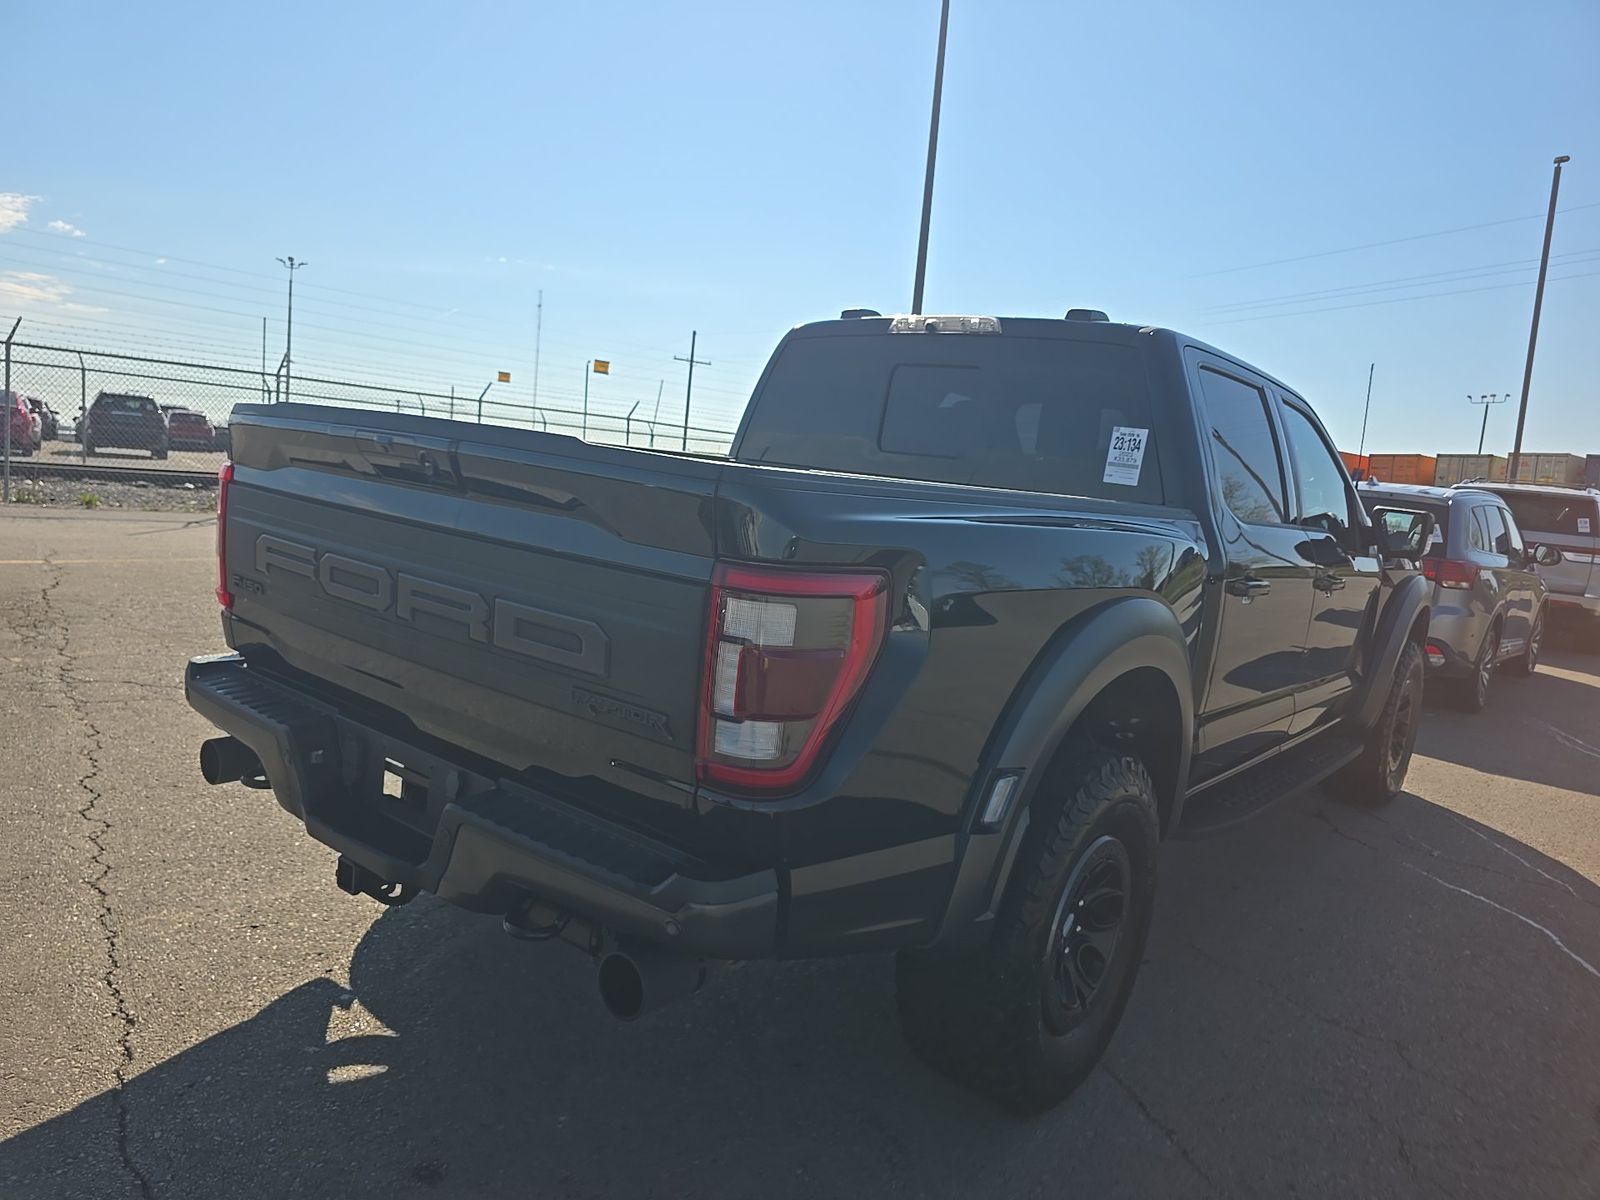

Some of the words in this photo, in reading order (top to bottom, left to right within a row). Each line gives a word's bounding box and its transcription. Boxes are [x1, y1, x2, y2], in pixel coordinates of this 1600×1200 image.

[1113, 437, 1142, 452] 23:134
[256, 533, 609, 678] FORD
[570, 685, 673, 740] RAPTOR
